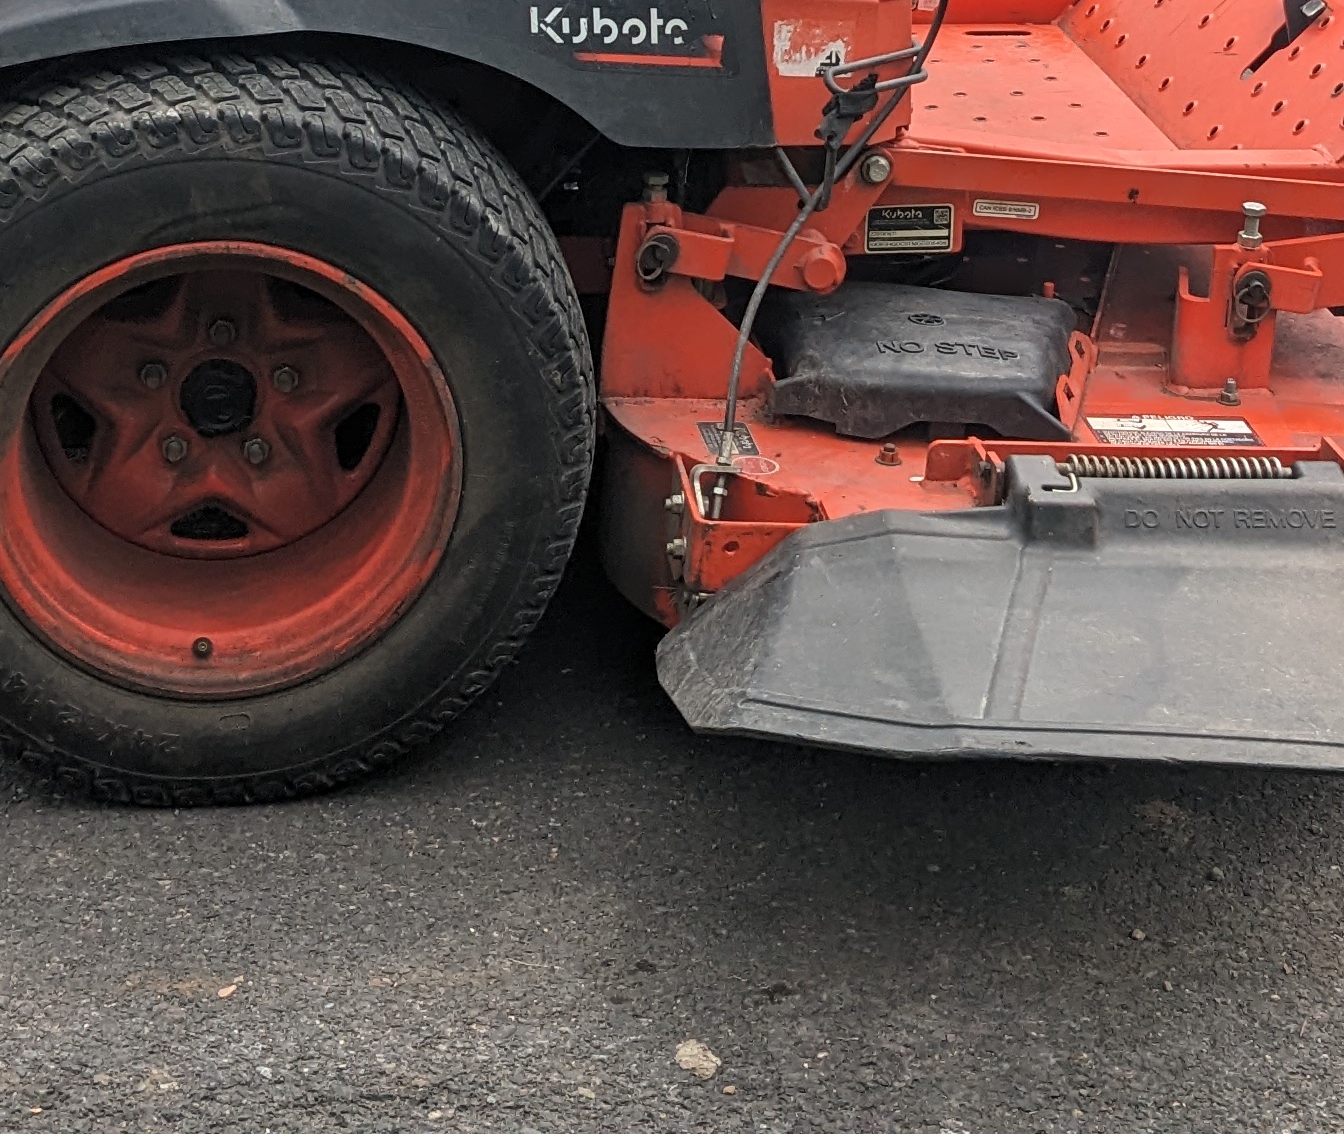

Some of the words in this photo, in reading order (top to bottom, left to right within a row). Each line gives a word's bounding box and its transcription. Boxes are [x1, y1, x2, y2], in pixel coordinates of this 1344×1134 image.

[530, 6, 689, 45] Kubota
[881, 208, 923, 219] Kubota
[875, 340, 926, 354] NO
[934, 341, 1020, 361] STEP
[1123, 509, 1160, 529] DO
[1175, 509, 1225, 529] NOT
[1233, 509, 1337, 529] REMOVE
